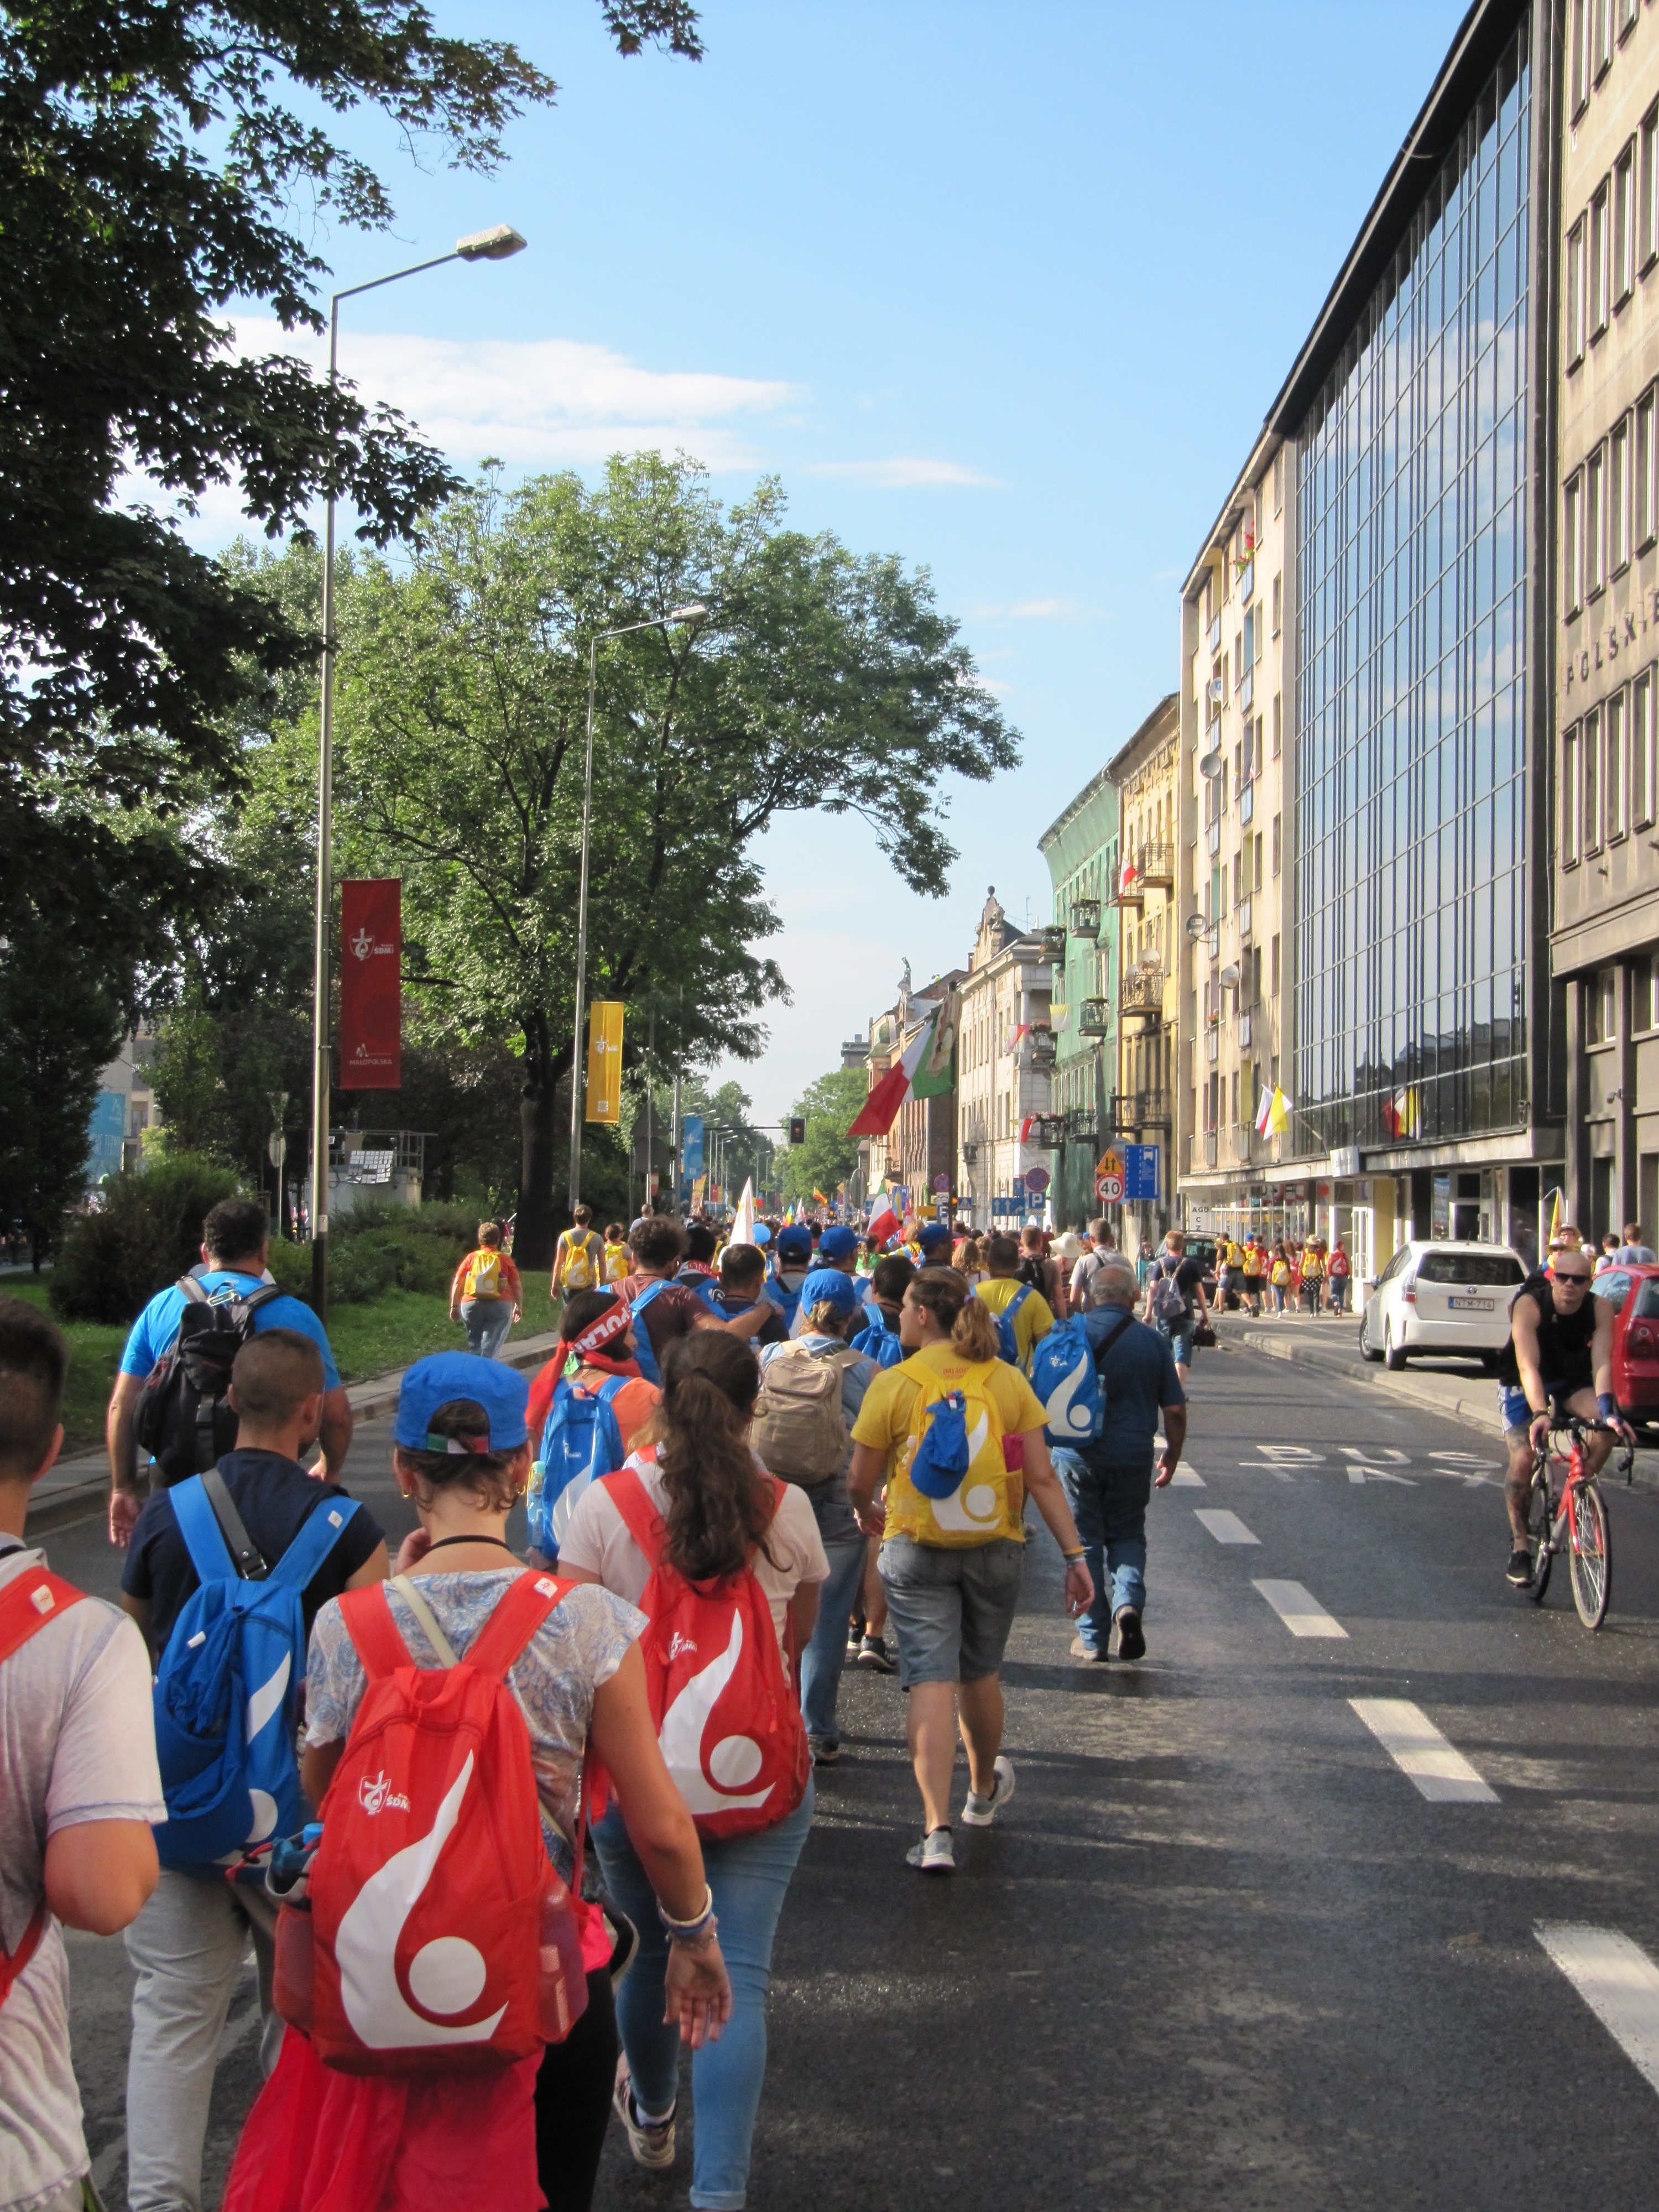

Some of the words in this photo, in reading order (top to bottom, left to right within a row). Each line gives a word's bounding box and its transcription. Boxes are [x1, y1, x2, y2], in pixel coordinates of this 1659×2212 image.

[1100, 1182, 1120, 1194] 40
[1032, 1193, 1042, 1207] P
[1454, 1300, 1491, 1308] NTM-714
[1255, 1445, 1503, 1468] BUS
